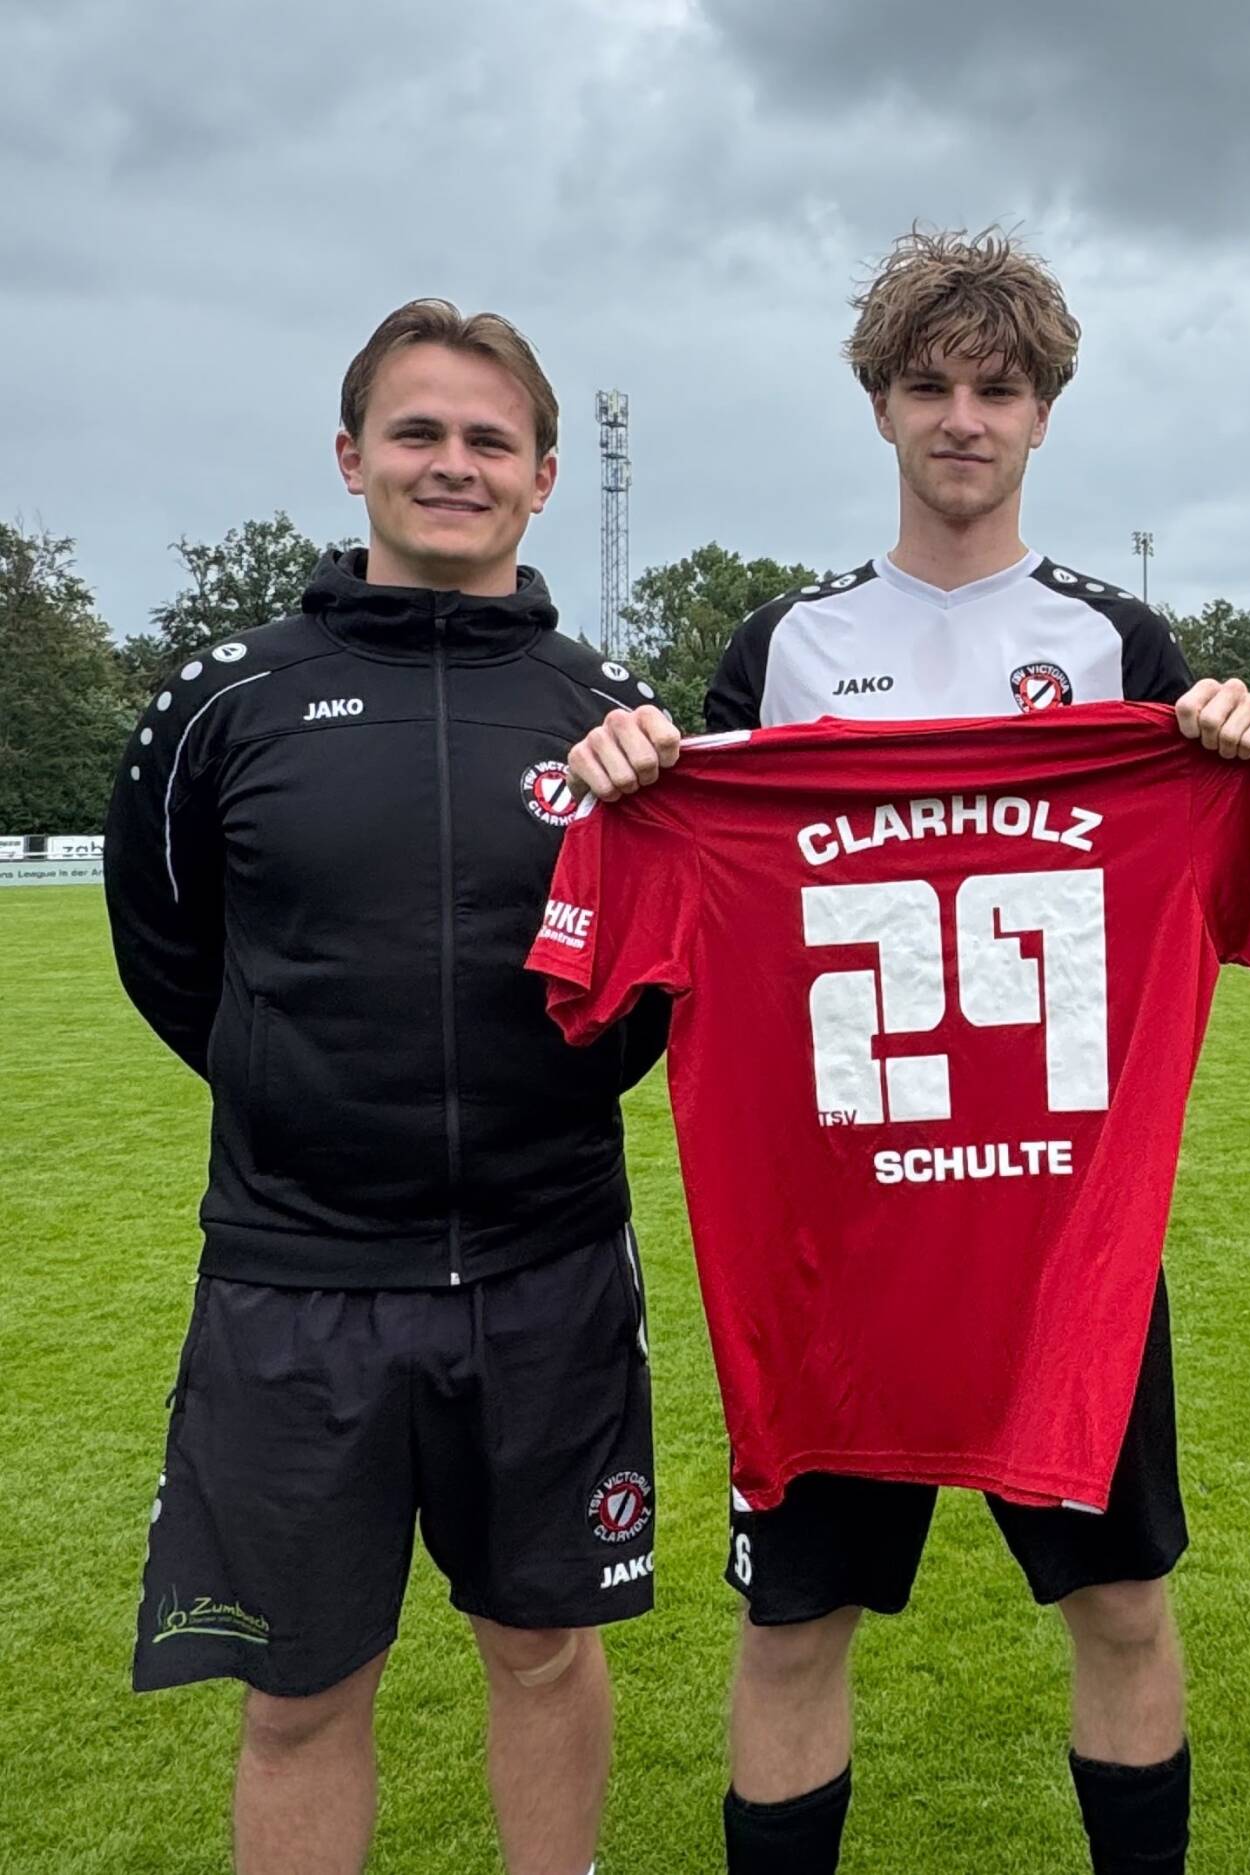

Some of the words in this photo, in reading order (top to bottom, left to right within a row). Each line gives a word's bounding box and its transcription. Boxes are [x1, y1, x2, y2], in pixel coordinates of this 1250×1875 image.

[832, 675, 894, 696] JAKO
[1026, 664, 1070, 695] VICTORIA
[303, 698, 364, 721] JAKO
[797, 796, 1103, 867] CLARHOLZ
[18, 869, 57, 880] League
[59, 869, 68, 877] in
[71, 868, 88, 877] der
[545, 900, 594, 937] HKE
[801, 867, 1110, 1127] 29
[817, 1109, 857, 1127] TSV
[873, 1140, 1074, 1185] SCHULTE
[588, 1488, 605, 1517] TSV
[603, 1471, 652, 1497] VICTORIA
[593, 1507, 652, 1543] CLARHOLZ
[731, 1526, 753, 1587] 6
